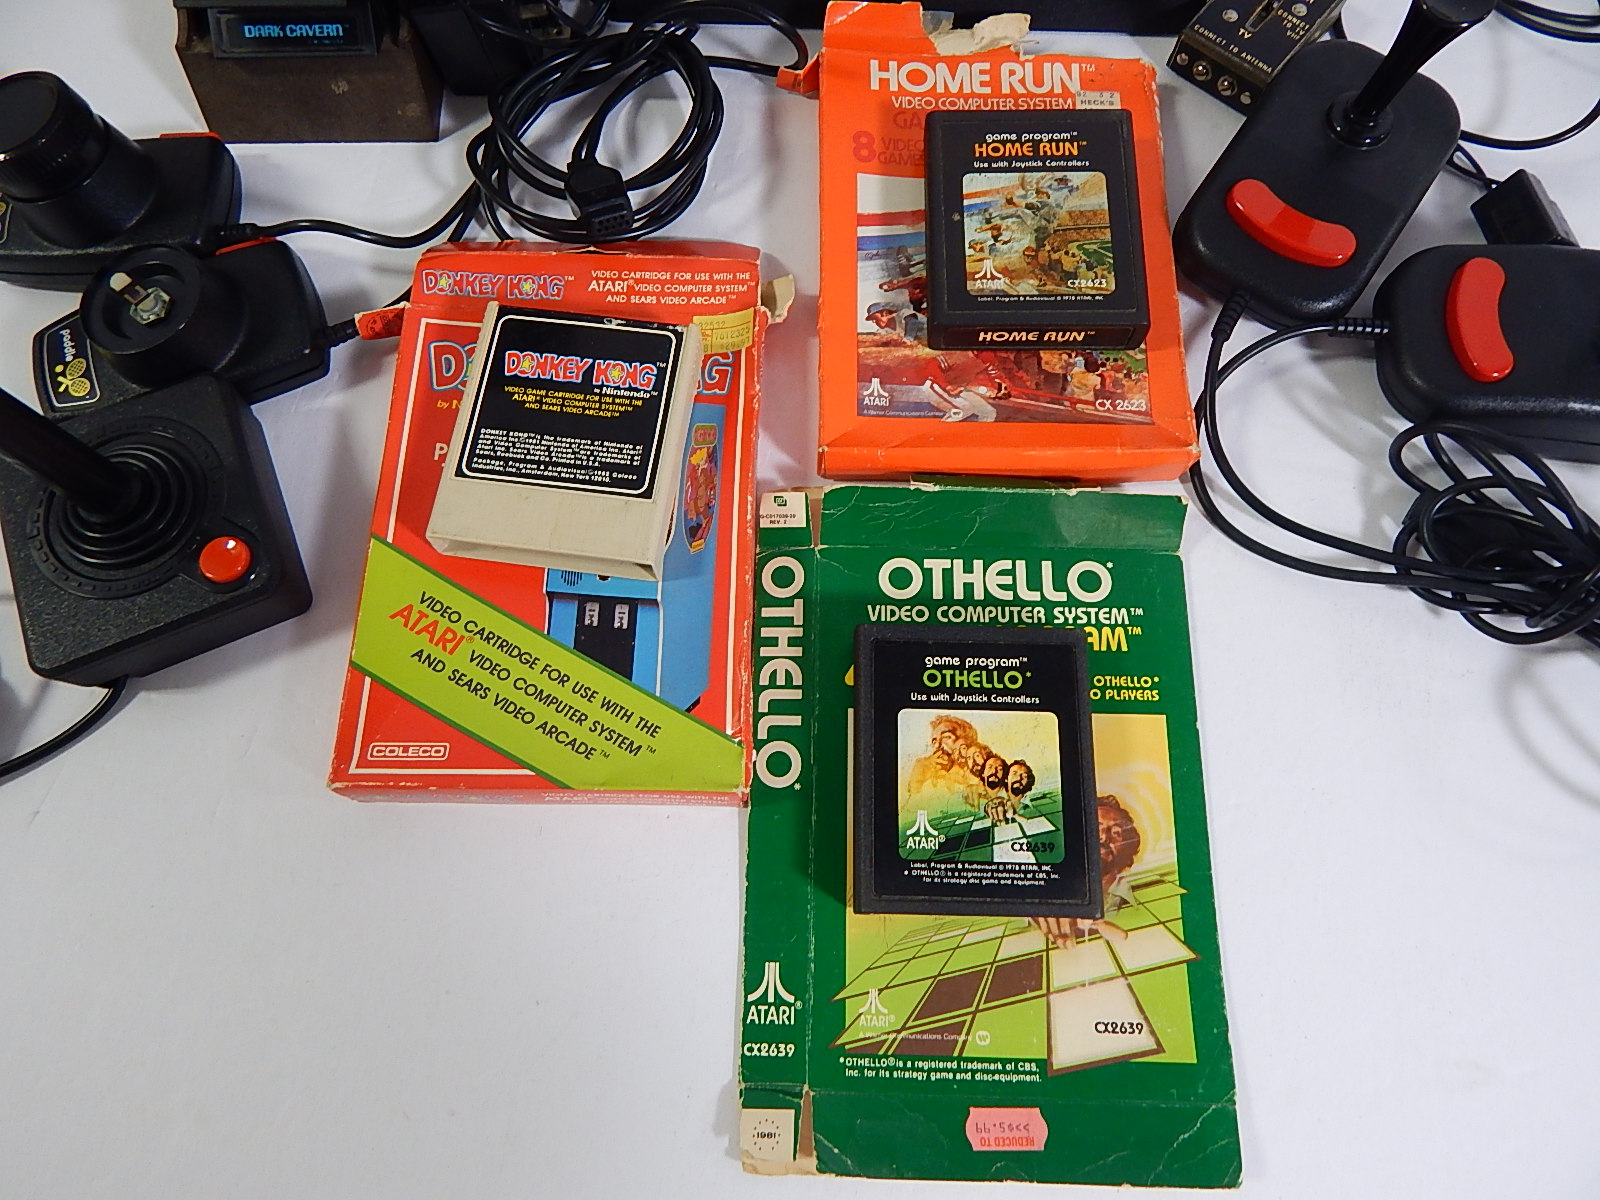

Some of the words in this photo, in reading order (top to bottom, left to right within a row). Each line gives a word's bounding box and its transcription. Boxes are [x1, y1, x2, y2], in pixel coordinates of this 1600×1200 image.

[1278, 9, 1310, 30] CONNECT
[244, 25, 283, 38] DARK
[285, 24, 344, 37] CAVERN
[1238, 27, 1252, 39] TV
[1194, 24, 1227, 46] CONNECT
[1229, 44, 1238, 53] TO
[1241, 51, 1273, 74] ANTENNA
[870, 59, 991, 94] HOME
[891, 96, 935, 109] VIDEO
[938, 97, 1014, 110] COMPUTER
[1018, 98, 1073, 110] SYSTEM
[985, 133, 1017, 142] game
[852, 130, 876, 163] 8
[880, 137, 925, 153] VIDEO
[974, 143, 1033, 158] HOME
[991, 160, 1008, 168] with
[1011, 160, 1043, 169] Joystick
[1045, 160, 1090, 168] Controllers
[621, 271, 671, 280] CARTRIDGE
[674, 272, 692, 280] FOR
[695, 272, 710, 281] USE
[713, 272, 733, 281] WITH
[736, 272, 750, 280] THE
[422, 269, 504, 298] DONKEY
[633, 283, 661, 292] VIDEO
[664, 284, 712, 293] COMPUTER
[975, 279, 1004, 289] ATARI
[1067, 279, 1107, 288] CX2623
[606, 294, 627, 303] AND
[630, 295, 657, 304] SEARS
[660, 296, 687, 304] VIDEO
[978, 331, 1039, 342] HOME
[59, 328, 76, 362] paddle
[504, 350, 593, 384] DONKEY
[504, 386, 525, 394] VIDEO
[526, 388, 546, 396] GAME
[548, 390, 585, 400] CARTRIDGE
[586, 394, 600, 402] FOR
[601, 396, 613, 404] USE
[615, 397, 630, 406] WITH
[631, 399, 643, 407] THE
[863, 396, 889, 407] ATARI
[437, 399, 450, 409] by
[524, 402, 540, 410] AND
[542, 404, 561, 412] SEARS
[562, 406, 583, 414] VIDEO
[542, 397, 563, 405] VIDEO
[564, 399, 600, 409] COMPUTER
[1095, 398, 1113, 411] CX
[1115, 399, 1147, 412] 2623
[867, 605, 929, 623] VIDEO
[936, 605, 1046, 624] COMPUTER
[419, 590, 462, 624] VIDEO
[463, 620, 541, 670] CARTRIDGE
[540, 663, 571, 688] FOR
[572, 681, 599, 703] USE
[600, 696, 635, 723] WITH
[634, 716, 662, 738] THE
[924, 656, 961, 668] game
[410, 648, 446, 673] AND
[447, 668, 491, 699] SEARS
[493, 693, 536, 725] VIDEO
[469, 650, 511, 681] VIDEO
[513, 677, 589, 727] COMPUTER
[910, 692, 928, 701] Use
[930, 692, 950, 702] with
[952, 692, 988, 704] Joystick
[990, 694, 1040, 704] Controllers
[1105, 689, 1160, 701] PLAYERS
[372, 746, 445, 757] COLECO
[1010, 841, 1055, 853] CX2639
[1094, 1021, 1144, 1035] CX2639
[743, 1042, 795, 1057] CX2639
[896, 1059, 903, 1067] is
[914, 1060, 957, 1070] registered
[960, 1061, 1002, 1070] trademark
[1005, 1062, 1014, 1070] of
[1018, 1062, 1040, 1072] CBS,
[845, 1068, 861, 1077] Inc.
[864, 1068, 876, 1077] for
[879, 1069, 889, 1078] its
[893, 1070, 927, 1080] strategy
[930, 1072, 954, 1081] game
[955, 1072, 971, 1080] and
[756, 1131, 777, 1139] 1981
[980, 1136, 992, 1147] TO
[994, 1136, 1035, 1147] REDUCED
